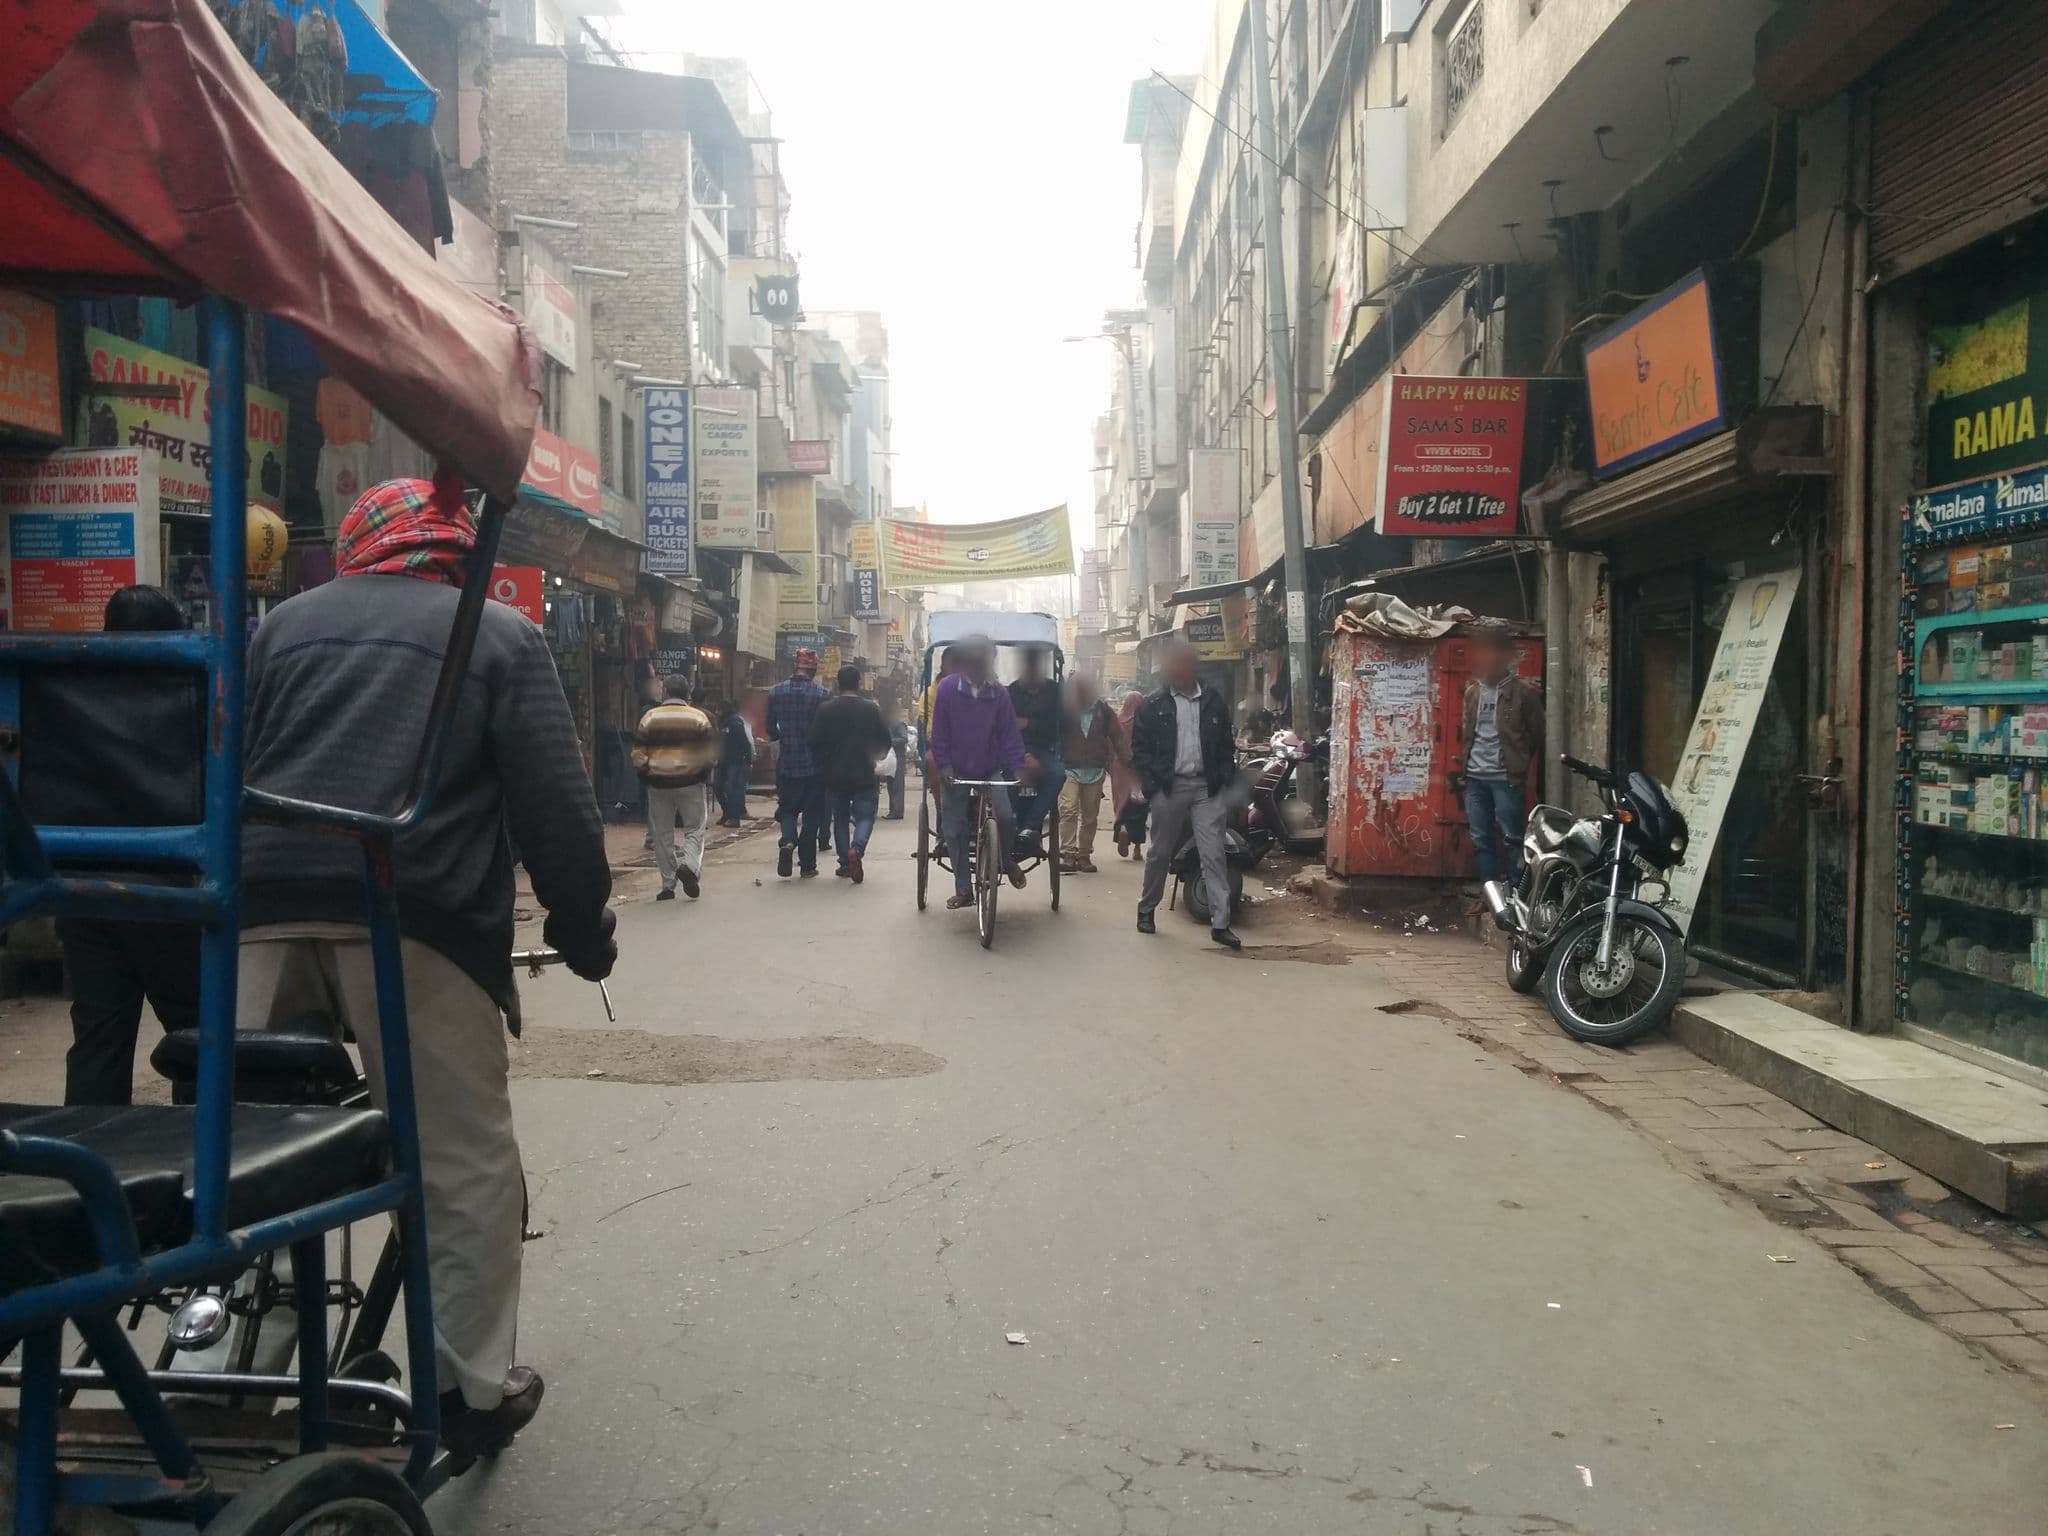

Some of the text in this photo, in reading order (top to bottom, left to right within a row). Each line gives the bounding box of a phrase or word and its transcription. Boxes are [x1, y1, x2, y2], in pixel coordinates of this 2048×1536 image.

[1400, 385, 1521, 401] HAPPY HOURS
[1472, 418, 1508, 434] BAR
[1953, 396, 2036, 460] RAMA
[647, 390, 685, 480] MONEY
[701, 448, 749, 457] EXPORTS
[1424, 447, 1482, 456] VIVEK HOTEL
[115, 456, 139, 477] CAFE
[1421, 464, 1443, 473] 12:00
[1444, 465, 1465, 473] Noon
[1466, 465, 1475, 473] to
[34, 484, 56, 504] FAST
[59, 484, 91, 504] LUNCH
[102, 483, 138, 504] DINNER
[647, 482, 689, 498] CHANGER
[648, 506, 687, 518] AIR
[1398, 495, 1506, 519] Buy 2 Get 1 Free
[648, 524, 688, 537] BUS
[259, 522, 275, 562] Kodak
[647, 536, 689, 550] TICKETS
[859, 571, 873, 609] MONEY
